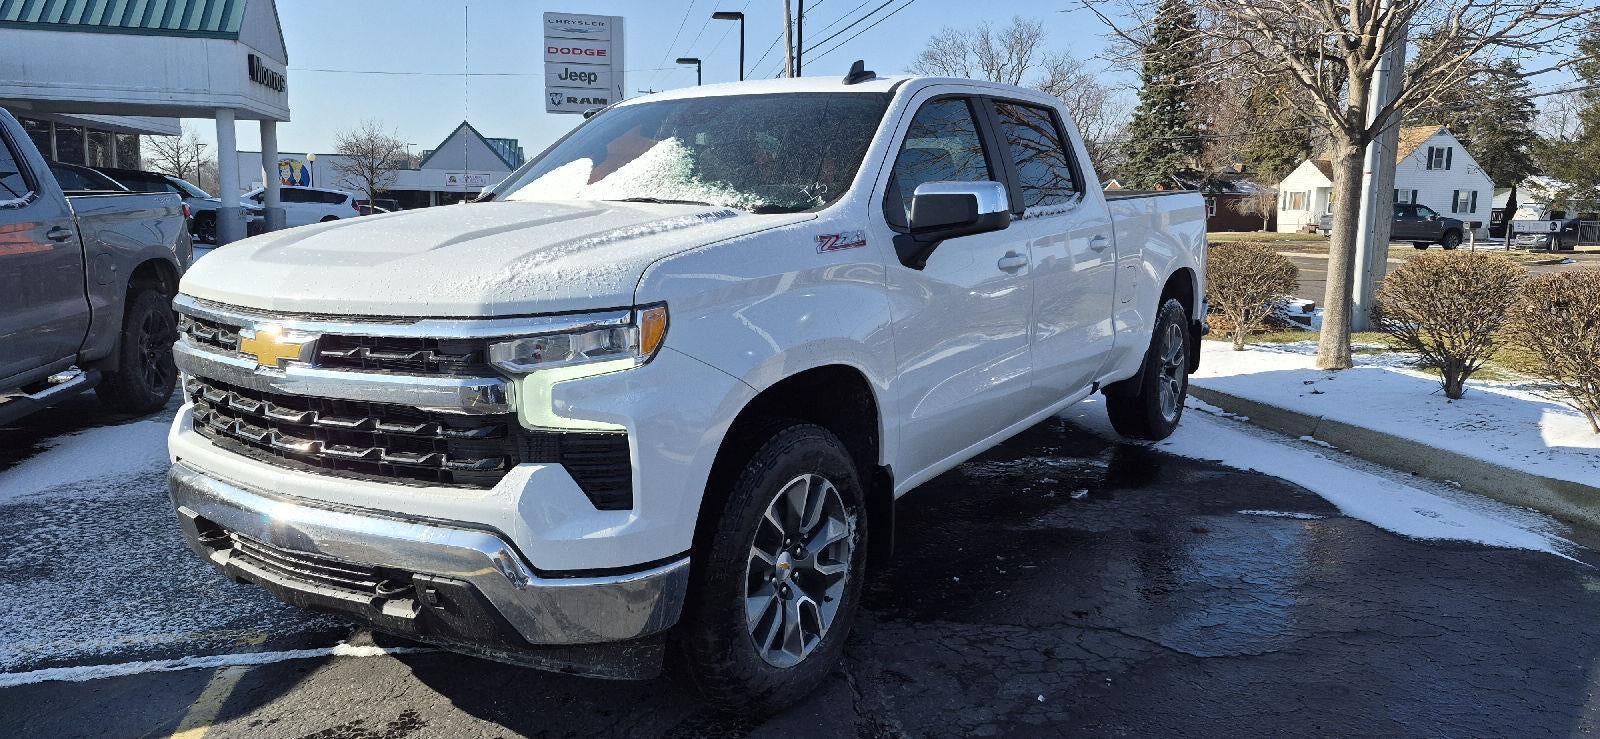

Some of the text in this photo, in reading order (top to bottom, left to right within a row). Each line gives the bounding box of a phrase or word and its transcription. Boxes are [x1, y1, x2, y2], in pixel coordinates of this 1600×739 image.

[547, 19, 605, 27] CHRYSLER
[547, 46, 607, 57] DODGE
[558, 67, 598, 85] Jeep
[566, 96, 608, 105] RAM
[815, 230, 867, 253] Z71
